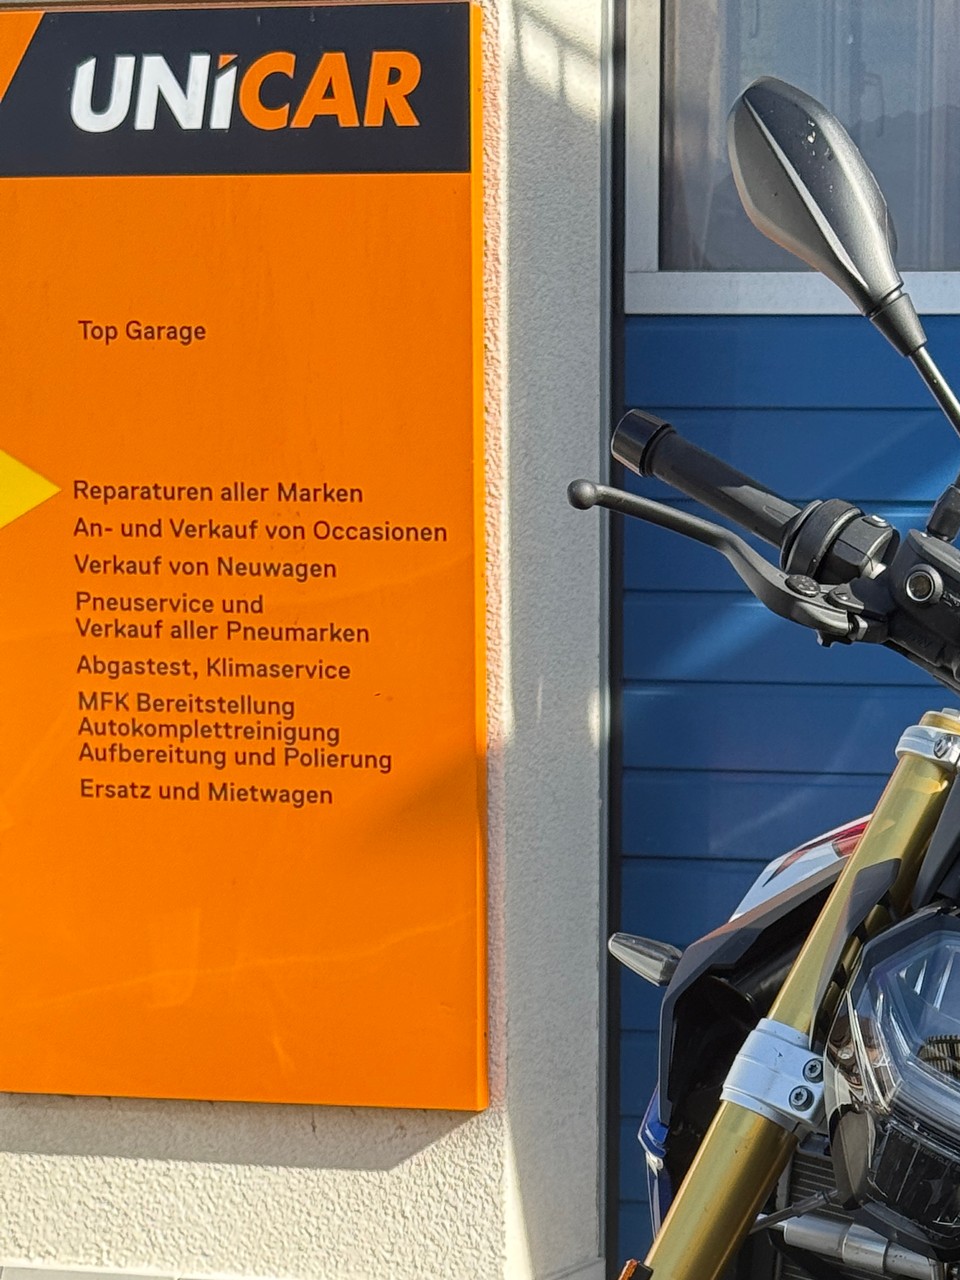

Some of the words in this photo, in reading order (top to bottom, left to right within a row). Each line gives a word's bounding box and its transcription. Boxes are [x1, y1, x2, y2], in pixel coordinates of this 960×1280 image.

[77, 320, 118, 346] Top
[125, 320, 206, 346] Garage
[73, 479, 213, 505] Reparaturen
[220, 481, 270, 502] aller
[277, 482, 363, 503] Marken
[73, 517, 113, 537] An-
[121, 518, 162, 538] und
[169, 518, 258, 540] Verkauf
[265, 525, 305, 540] von
[313, 520, 447, 542] Occasionen
[74, 554, 162, 575] Verkauf
[168, 561, 209, 576] von
[217, 556, 337, 583] Neuwagen
[76, 591, 214, 614] Pneuservice
[222, 594, 264, 614] und
[75, 617, 163, 639] Verkauf
[170, 619, 219, 640] aller
[227, 620, 369, 643] Pneumarken
[76, 655, 198, 680] Abgastest,
[207, 657, 351, 680] Klimaservice
[78, 691, 129, 711] MFK
[136, 692, 295, 721] Bereitstellung
[78, 716, 340, 748] Autokomplettreinigung
[79, 742, 226, 771] Aufbereitung
[234, 747, 276, 766] und
[284, 747, 392, 774] Polierung
[80, 778, 151, 799] Ersatz
[159, 781, 200, 801] und
[208, 782, 333, 809] Mietwagen
